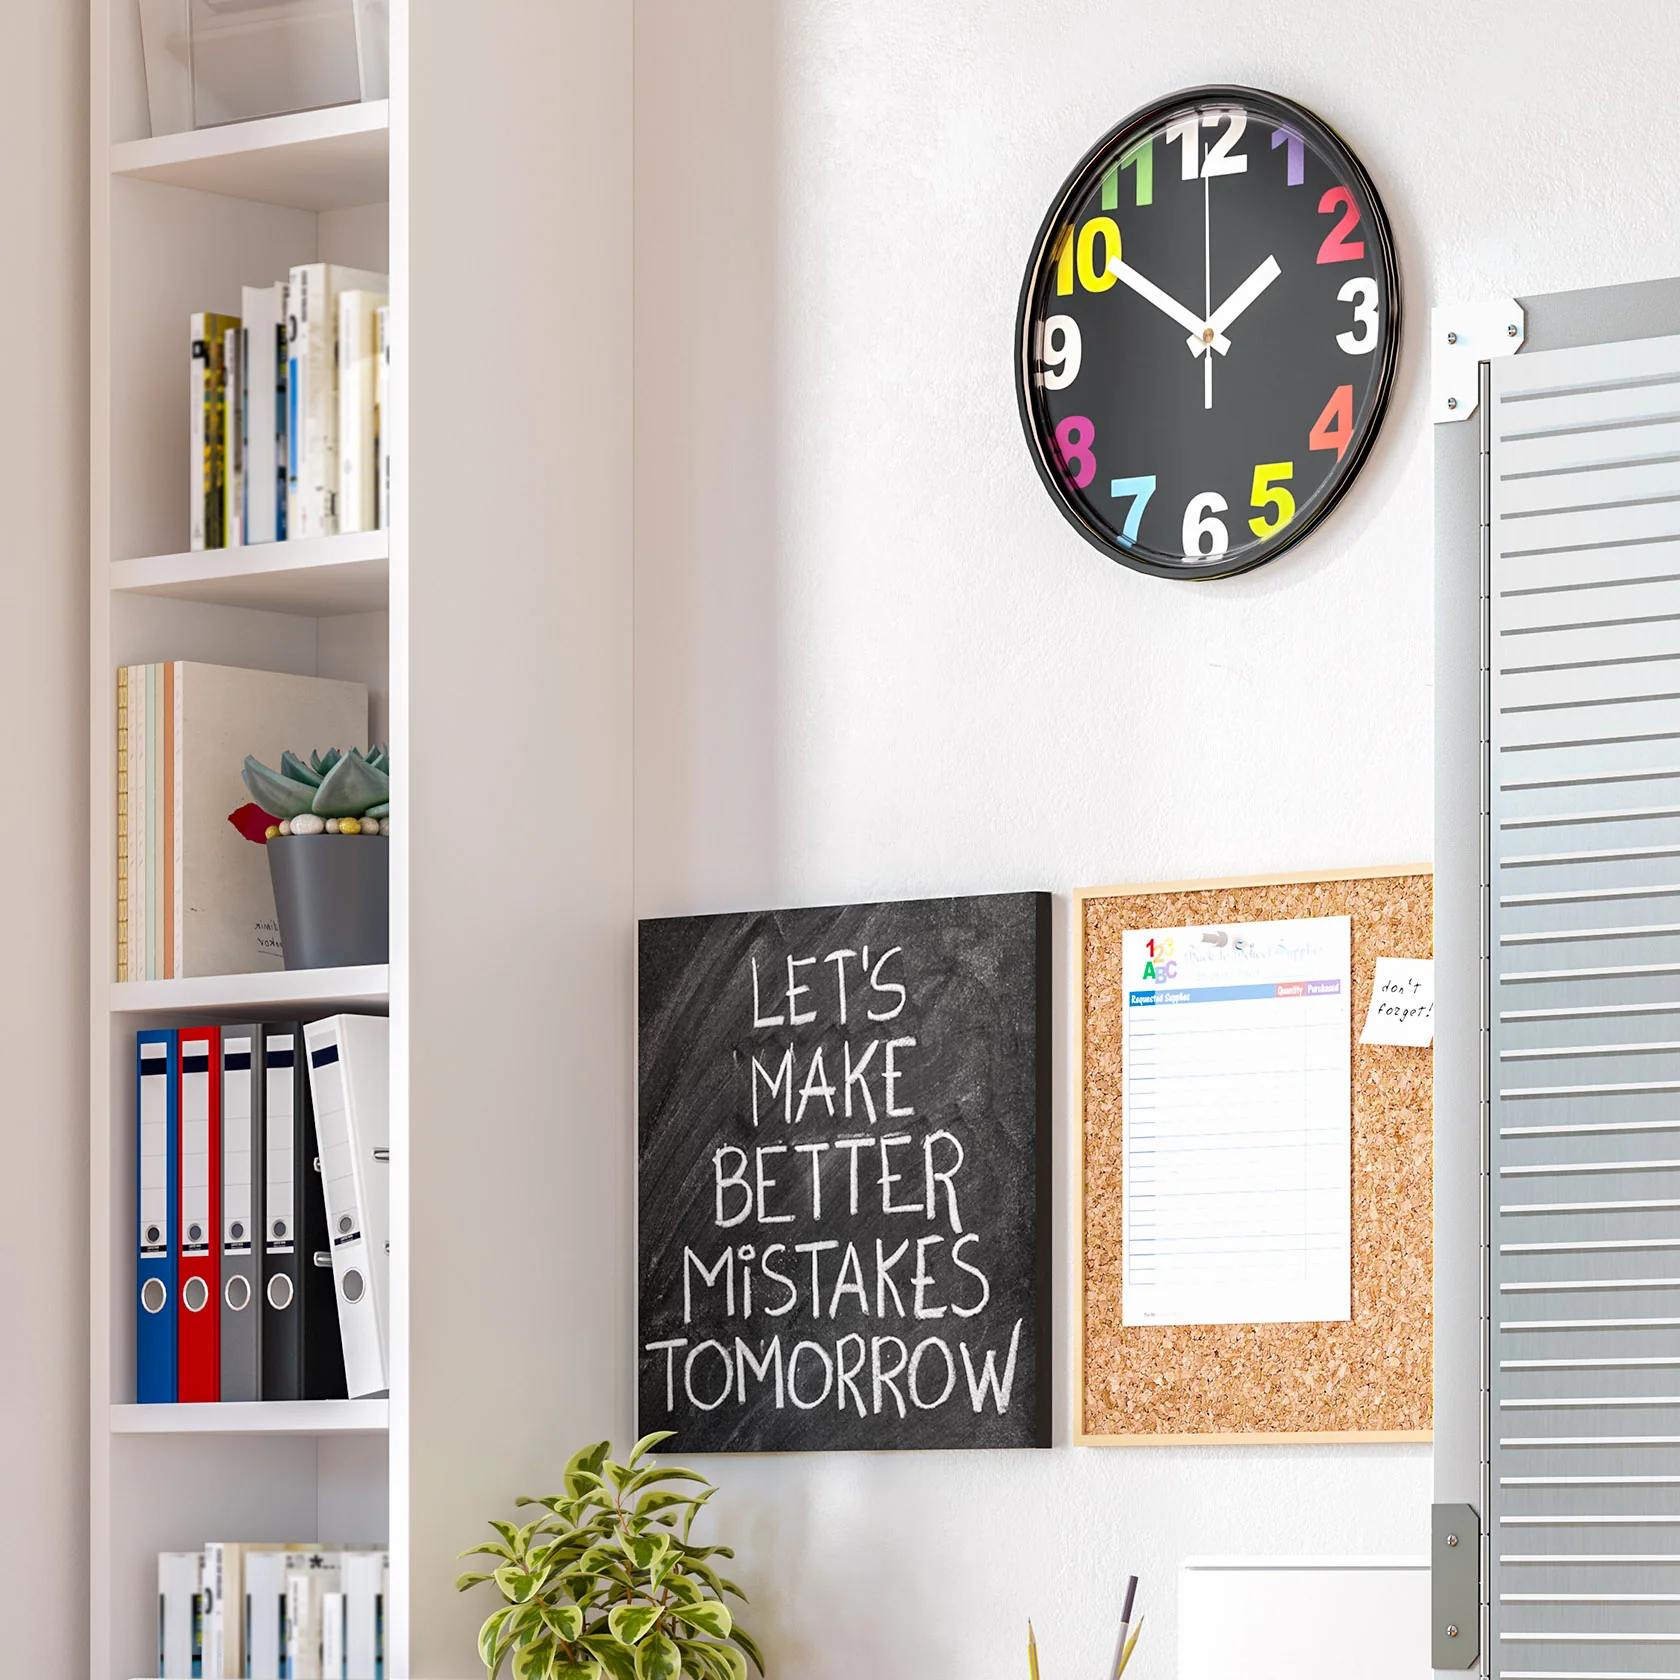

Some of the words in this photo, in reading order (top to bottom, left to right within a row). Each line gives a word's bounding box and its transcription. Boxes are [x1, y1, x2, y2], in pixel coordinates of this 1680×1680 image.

[1166, 109, 1248, 181] 12
[1271, 119, 1305, 187] 1
[1055, 216, 1123, 297] 10
[1316, 186, 1366, 265] 2
[1043, 314, 1083, 391] 9
[1336, 277, 1380, 355] 3
[1050, 415, 1097, 491] 8
[1309, 384, 1355, 463] 4
[1110, 475, 1157, 548] 7
[1182, 491, 1230, 562] 6
[1249, 461, 1296, 541] 5
[752, 945, 907, 1028] LET'S
[1131, 994, 1164, 1006] Requested
[1143, 960, 1178, 985] ABC
[1381, 978, 1423, 995] don't
[1378, 1002, 1434, 1022] forget!
[751, 1036, 918, 1128] MAKE
[712, 1128, 965, 1234] BETTER
[645, 1318, 1023, 1419] TOMORROW
